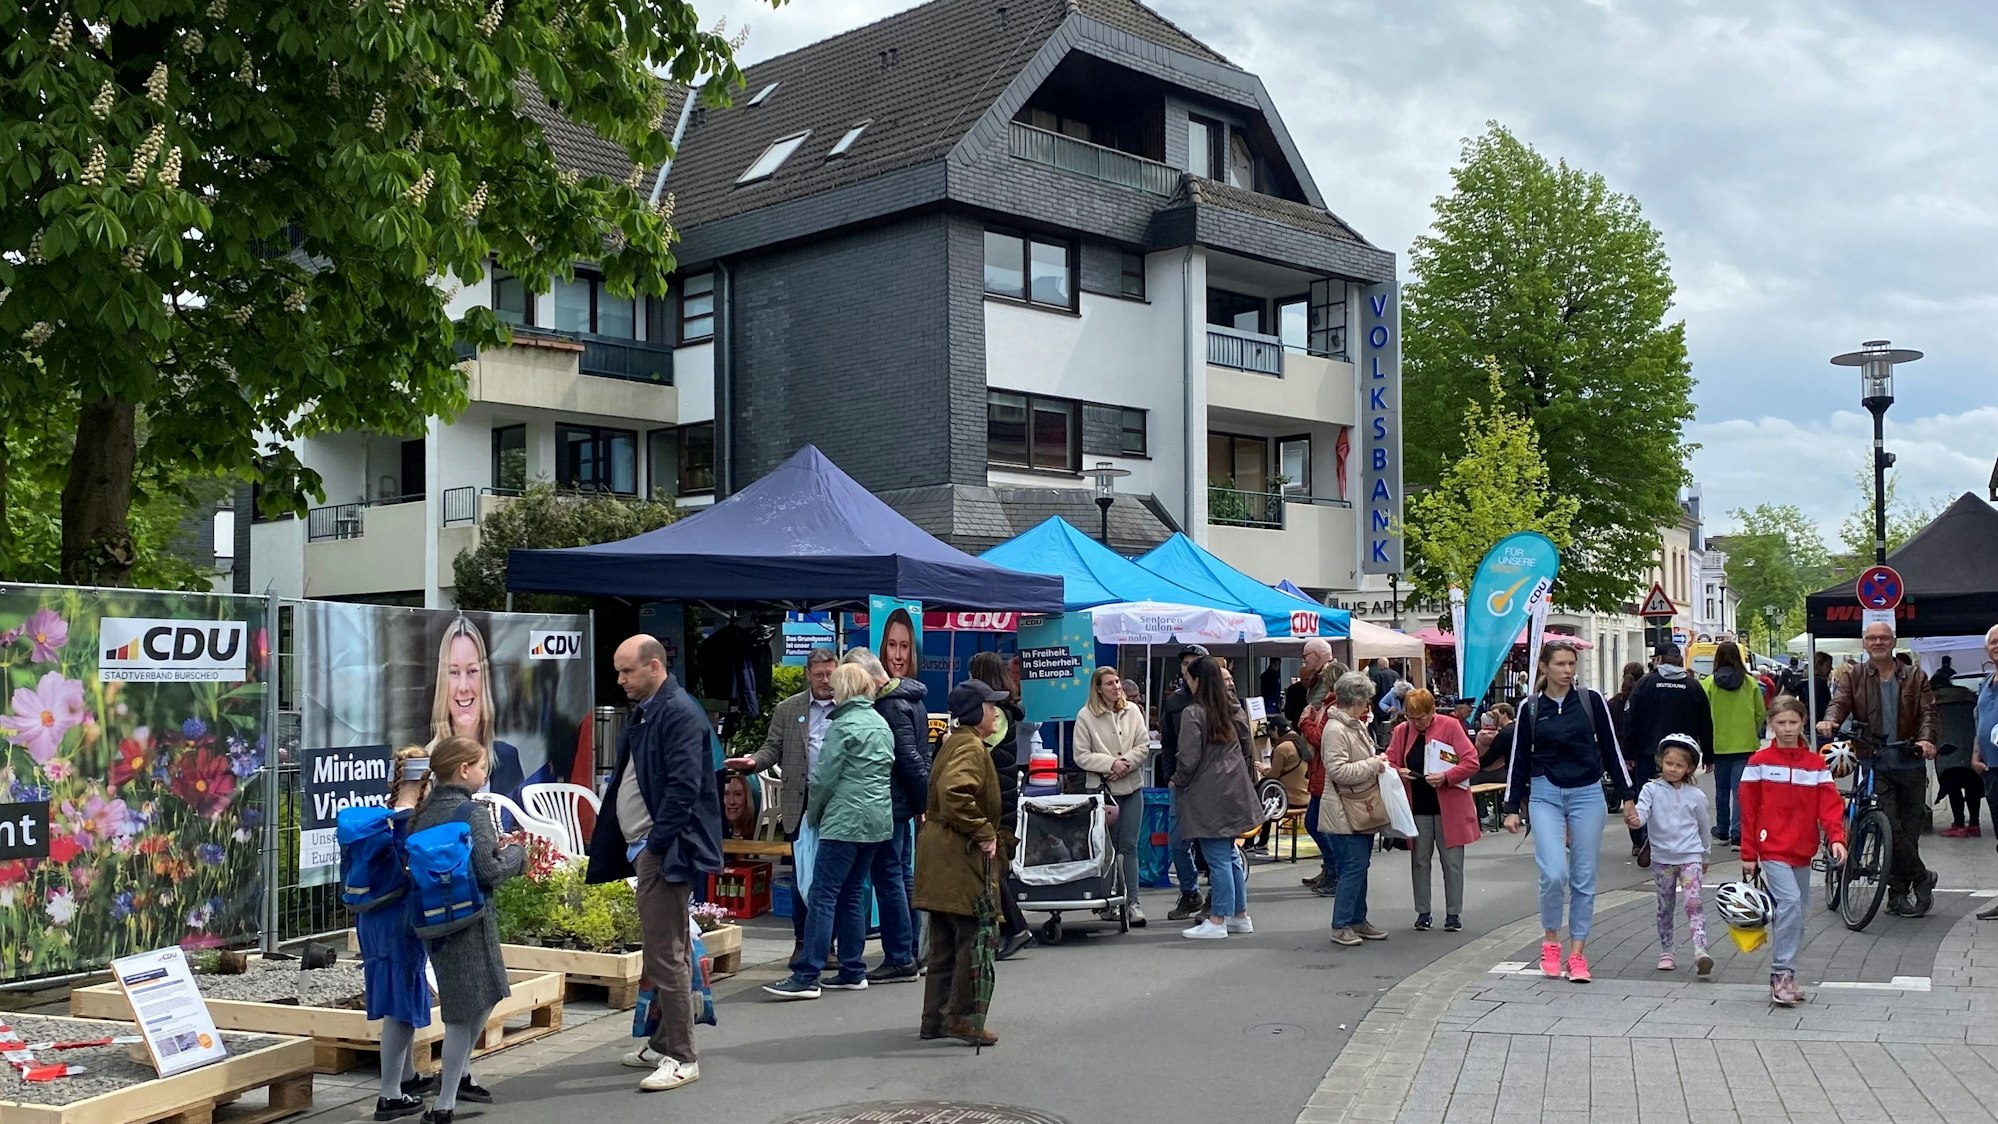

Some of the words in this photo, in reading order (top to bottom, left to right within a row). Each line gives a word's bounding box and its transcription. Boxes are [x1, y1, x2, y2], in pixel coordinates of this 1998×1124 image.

[1369, 294, 1391, 563] VOLKSBANK
[1504, 546, 1524, 557] FÜR
[1497, 556, 1536, 567] UNSERE
[1530, 581, 1547, 604] CDU
[957, 612, 1012, 629] CDU
[1291, 612, 1319, 634] CDU
[143, 626, 240, 661] CDU
[544, 636, 581, 655] CDU
[1022, 650, 1031, 658] In
[1032, 648, 1068, 658] Freiheit.
[1023, 661, 1031, 669] In
[1033, 657, 1081, 668] Sicherheit.
[104, 671, 173, 680] STADTVERBAND
[174, 671, 218, 680] BURSCHEID
[1029, 670, 1038, 679] In
[1039, 669, 1073, 678] Europa.
[312, 752, 386, 784] Miriam
